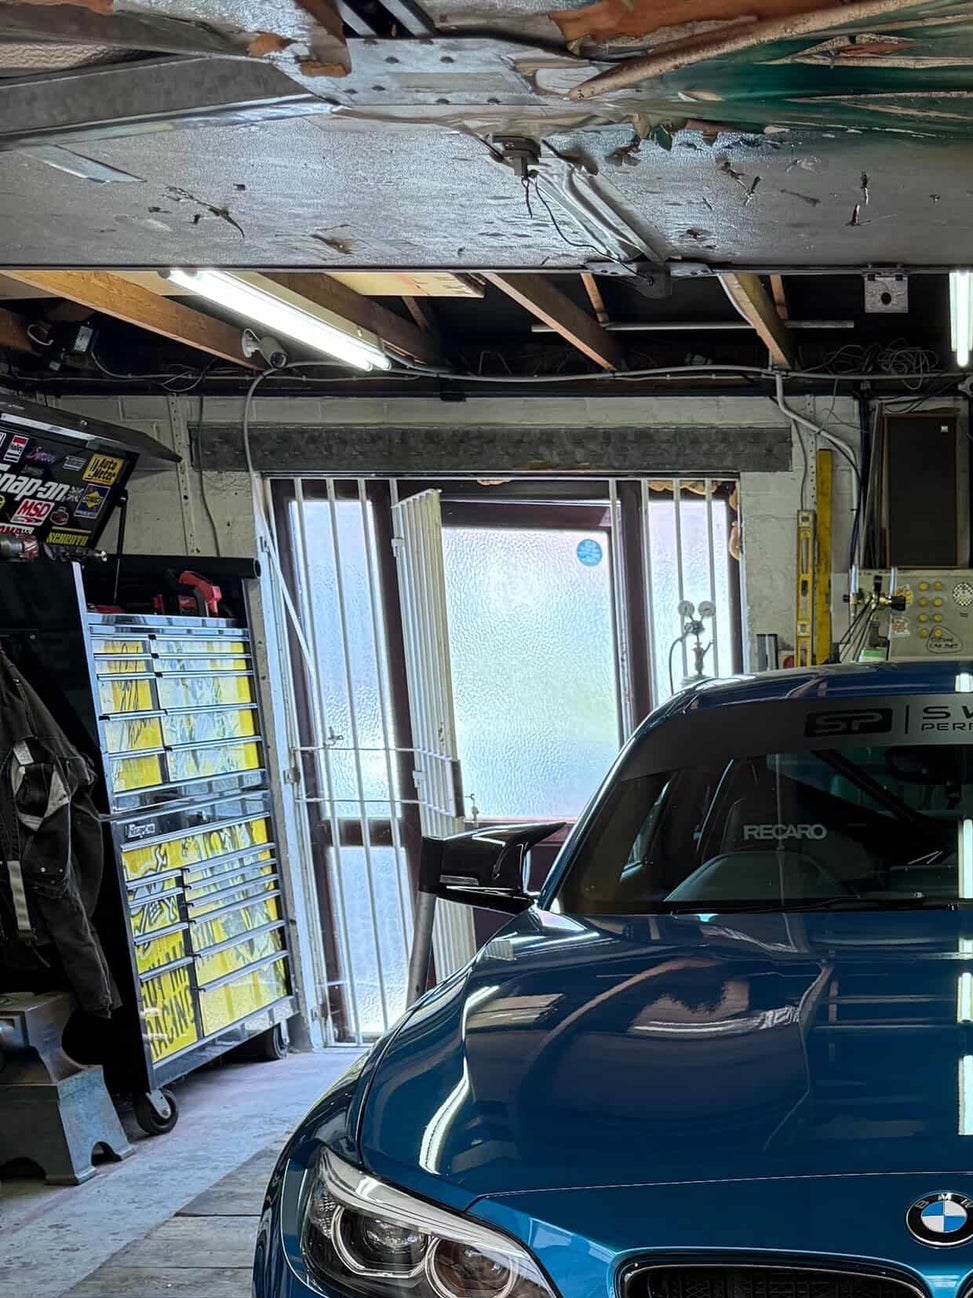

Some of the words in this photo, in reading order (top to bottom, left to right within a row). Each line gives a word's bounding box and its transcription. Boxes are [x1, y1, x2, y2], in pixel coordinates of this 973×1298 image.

[0, 473, 70, 501] nap-on
[17, 501, 51, 518] MSD
[743, 823, 828, 840] RECARO
